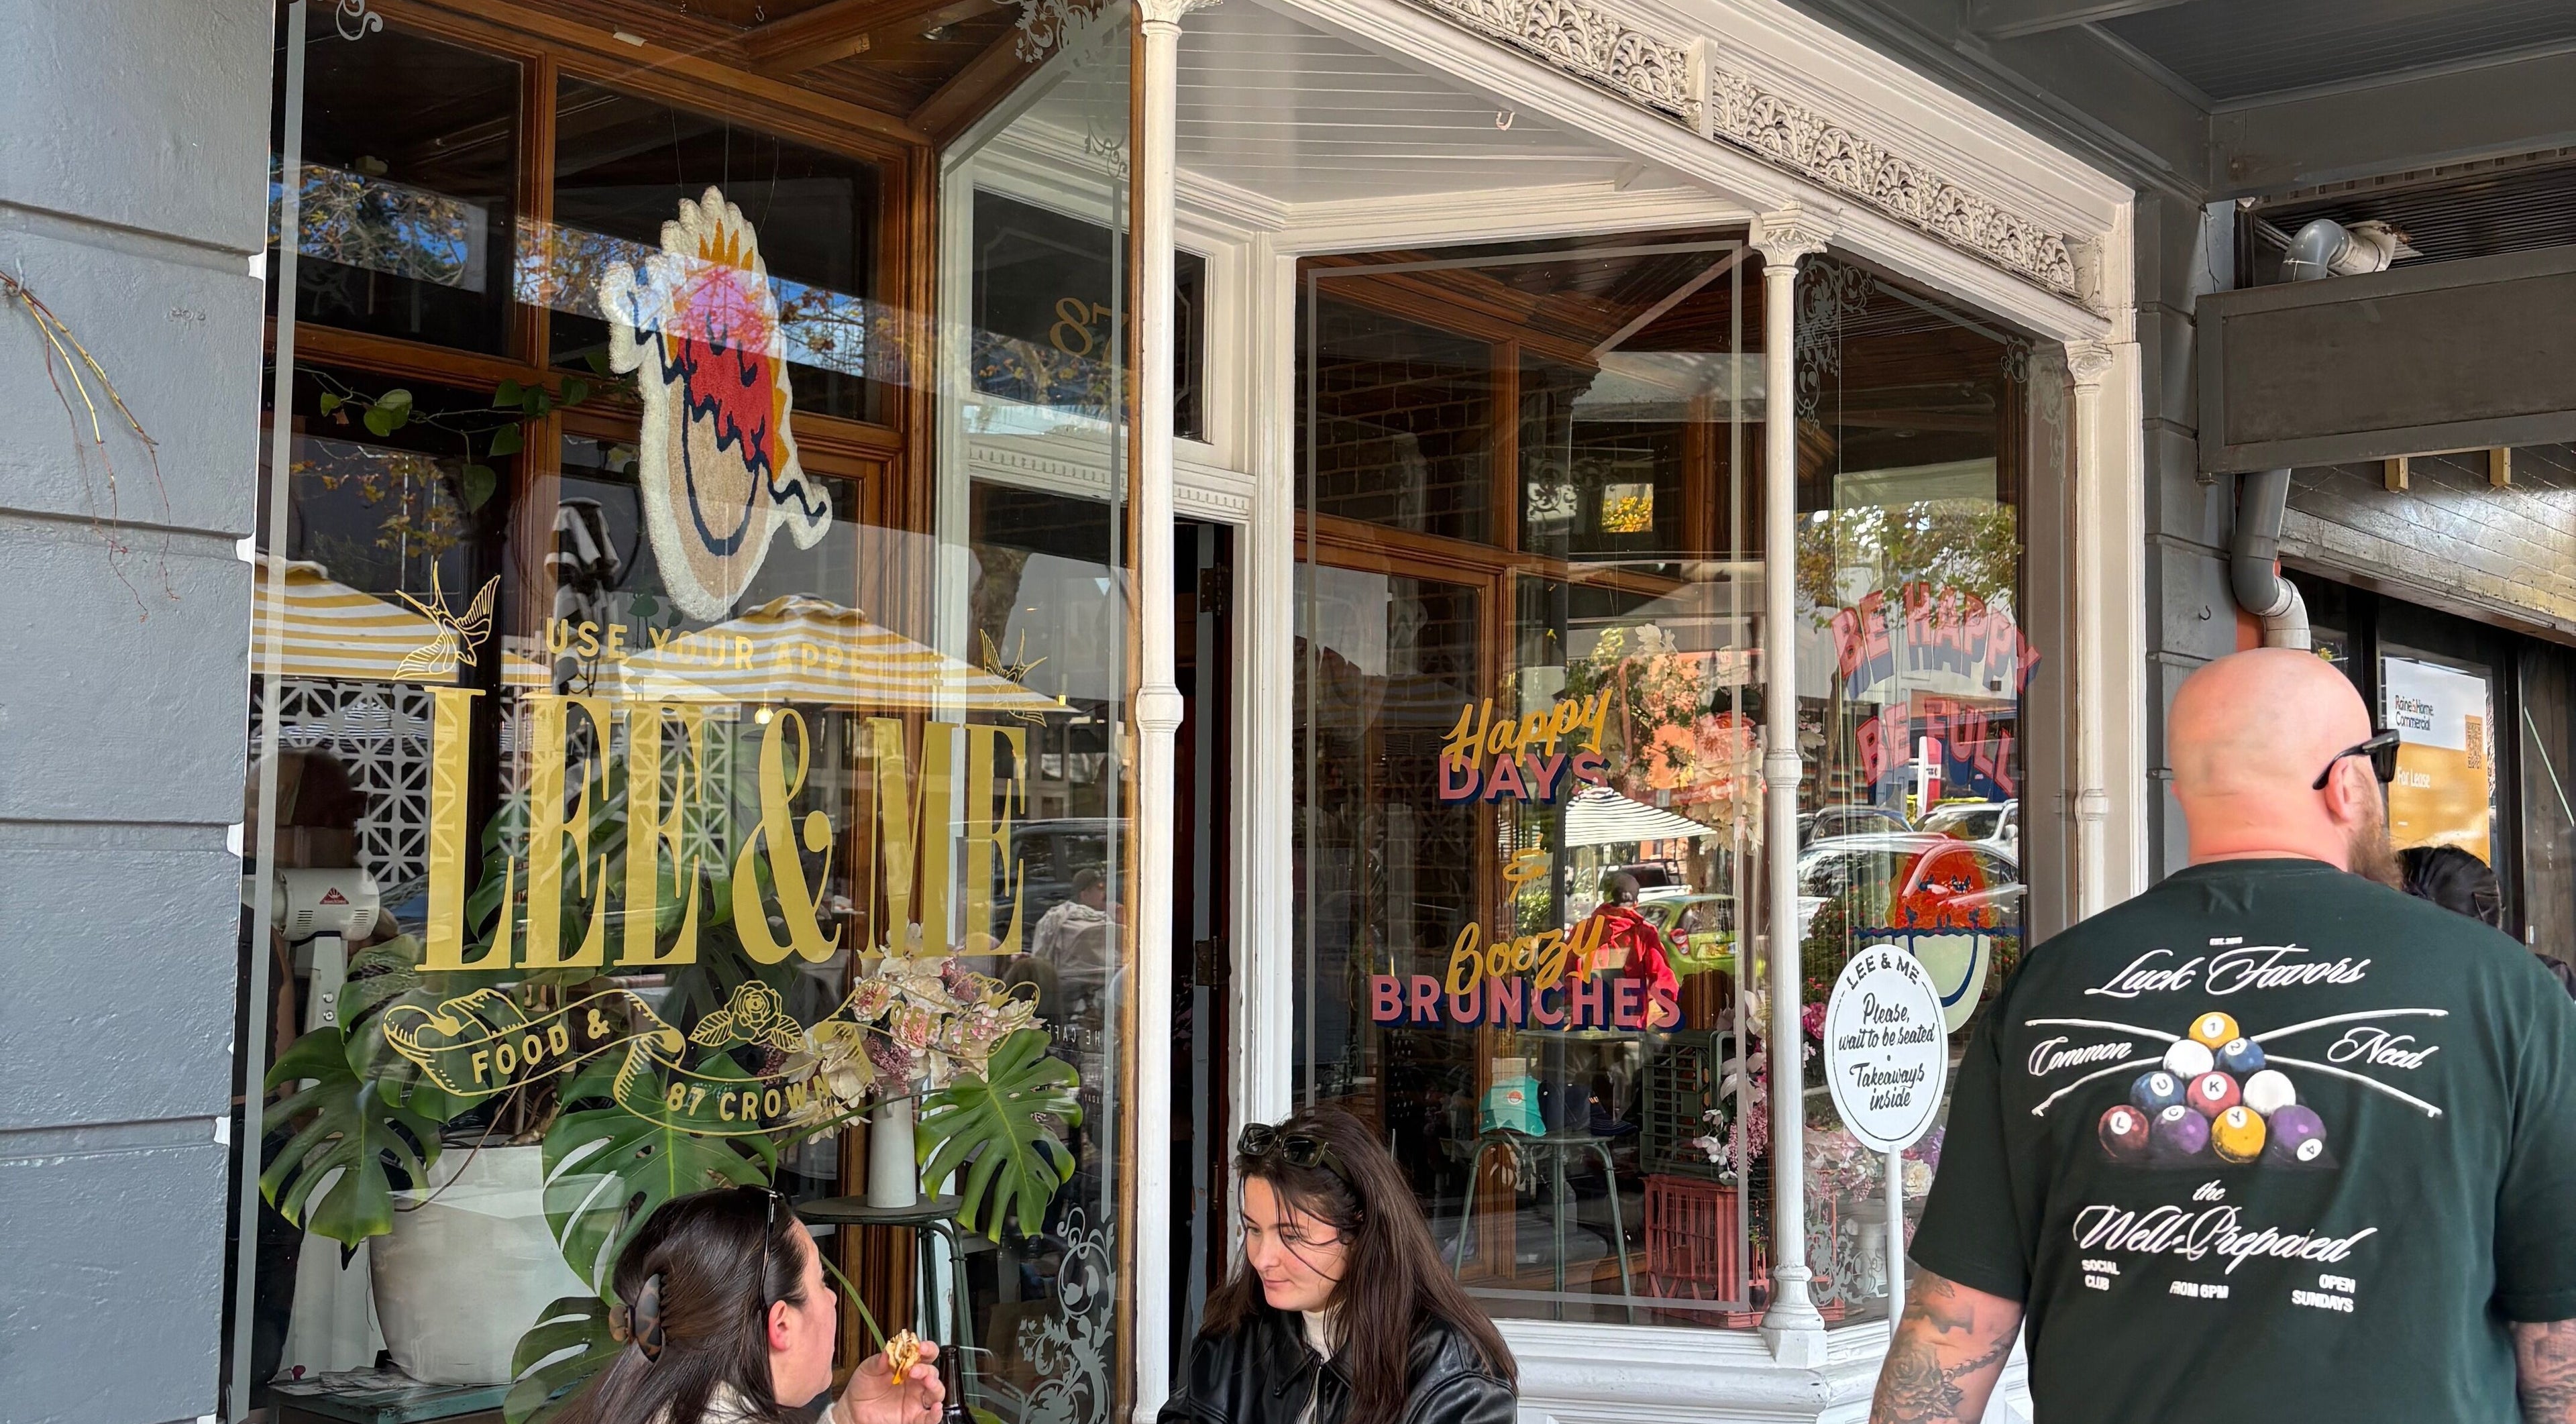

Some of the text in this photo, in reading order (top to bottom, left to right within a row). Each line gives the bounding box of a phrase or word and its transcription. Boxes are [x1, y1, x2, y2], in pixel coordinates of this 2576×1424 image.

[1050, 297, 1130, 366] 87
[545, 616, 627, 659] USE
[649, 626, 754, 670] YOUR
[1831, 582, 2042, 699] BE HAPPY
[1440, 689, 1613, 773] Happy
[2396, 711, 2431, 731] Commercial
[1856, 697, 2015, 803] BE FULL
[1439, 753, 1611, 804] DAYS
[2397, 766, 2431, 789] For Lease
[414, 685, 1026, 971] LEE & ME
[1503, 833, 1547, 903] &
[1445, 914, 1605, 995] Boozy
[1846, 952, 1920, 990] LEE & ME
[2084, 943, 2371, 999] Luck Favors
[1372, 975, 1685, 1033] BRUNCHES
[1862, 992, 1910, 1025] Please,
[472, 1024, 570, 1084] FOOD
[587, 1008, 610, 1040] &
[1838, 1022, 1935, 1051] wait to be seated
[2210, 1022, 2216, 1032] 1
[2231, 1041, 2241, 1051] 2
[2028, 1036, 2133, 1077] Common
[2326, 1026, 2440, 1070] Need
[1849, 1061, 1925, 1089] Takeaways
[2156, 1079, 2220, 1093] U K
[666, 1072, 835, 1121] 87 CROWN
[1869, 1086, 1912, 1111] inside
[2116, 1117, 2125, 1130] L
[2169, 1107, 2180, 1117] C
[2231, 1111, 2242, 1123] Y
[2192, 1179, 2226, 1201] the
[2072, 1205, 2378, 1275] Well-Prepared
[2081, 1259, 2121, 1275] SOCIAL
[2084, 1274, 2110, 1291] CLUB
[2318, 1274, 2356, 1294] OPEN
[2200, 1284, 2229, 1299] 6PM
[2292, 1289, 2354, 1313] SUNDAYS
